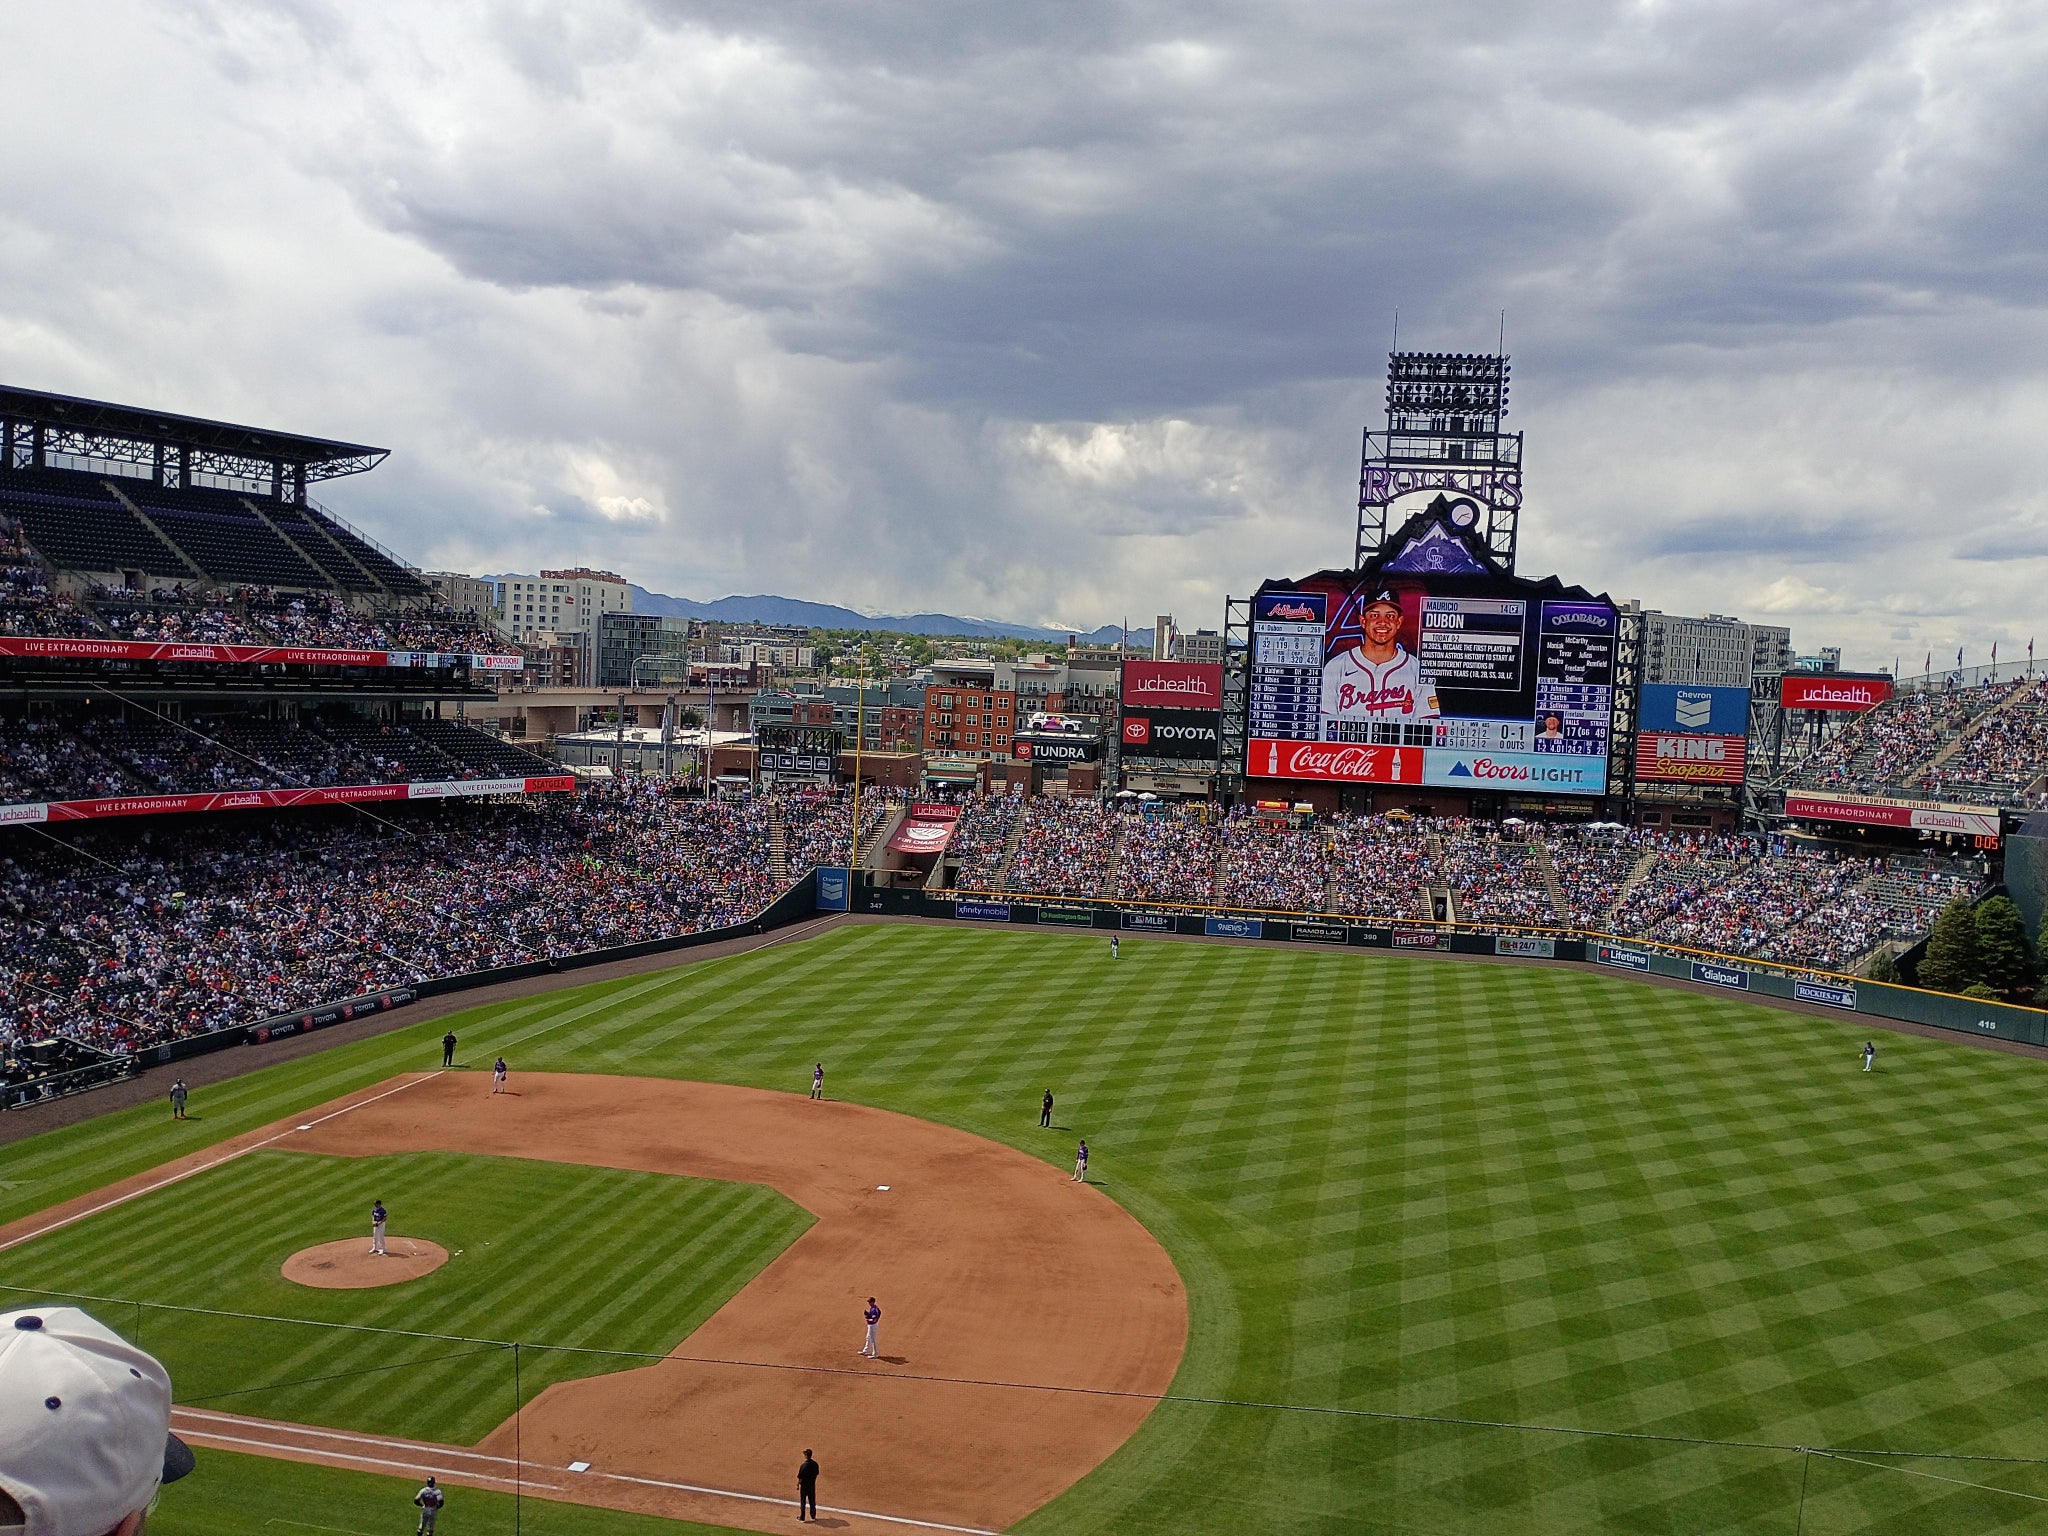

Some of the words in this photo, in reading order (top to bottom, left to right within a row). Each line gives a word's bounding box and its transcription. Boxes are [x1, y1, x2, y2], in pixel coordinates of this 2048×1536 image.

[1360, 467, 1522, 508] ROCKIES
[1427, 602, 1458, 611] MAURICIO
[1426, 613, 1464, 628] DUBON
[1552, 613, 1607, 627] COLORADO
[25, 643, 44, 651] LIVE
[48, 643, 129, 653] EXTRAORDINARY
[172, 645, 215, 659] uchealth
[307, 652, 370, 661] EXTRAORDINARY
[1138, 674, 1206, 693] uchealth
[1338, 684, 1405, 712] Braves
[1804, 685, 1871, 703] uchealth
[1154, 726, 1216, 740] TOYOTA
[1567, 727, 1575, 736] 17
[1595, 728, 1605, 737] 49
[1471, 739, 1475, 747] 2
[1550, 745, 1564, 753] 4.01
[1657, 738, 1725, 760] KING
[1032, 745, 1085, 758] TUNDRA
[1290, 746, 1379, 777] Coca-Cola
[1473, 758, 1529, 779] Coors
[1532, 768, 1582, 784] LIGHT
[1654, 758, 1725, 780] Soopers
[414, 785, 443, 796] uchealth
[532, 779, 566, 789] SEATGEEK
[224, 794, 261, 805] uchealth
[341, 789, 396, 798] EXTRAORDINARY
[115, 800, 187, 811] EXTRAORDINARY
[1837, 795, 1863, 803] PROUDLY
[1866, 798, 1897, 806] POWERING
[1908, 801, 1940, 810] COLORADO
[0, 807, 40, 821] uchealth
[918, 805, 957, 816] uchealth
[1796, 804, 1814, 813] LIVE
[1817, 806, 1893, 820] EXTRAORDINARY
[1919, 814, 1964, 828] uchealth
[1975, 835, 1998, 850] 0:05
[958, 906, 982, 915] xfinity
[983, 907, 1008, 916] mobile
[1519, 942, 1535, 950] 24/7
[1611, 950, 1646, 964] Lifetime
[1704, 968, 1739, 985] dialpad
[392, 994, 411, 1003] TOYOTA
[355, 1003, 374, 1012] TOYOTA
[315, 1014, 336, 1024] TOYOTA
[1978, 1021, 1996, 1029] 415
[271, 1024, 294, 1035] TOYOTA
